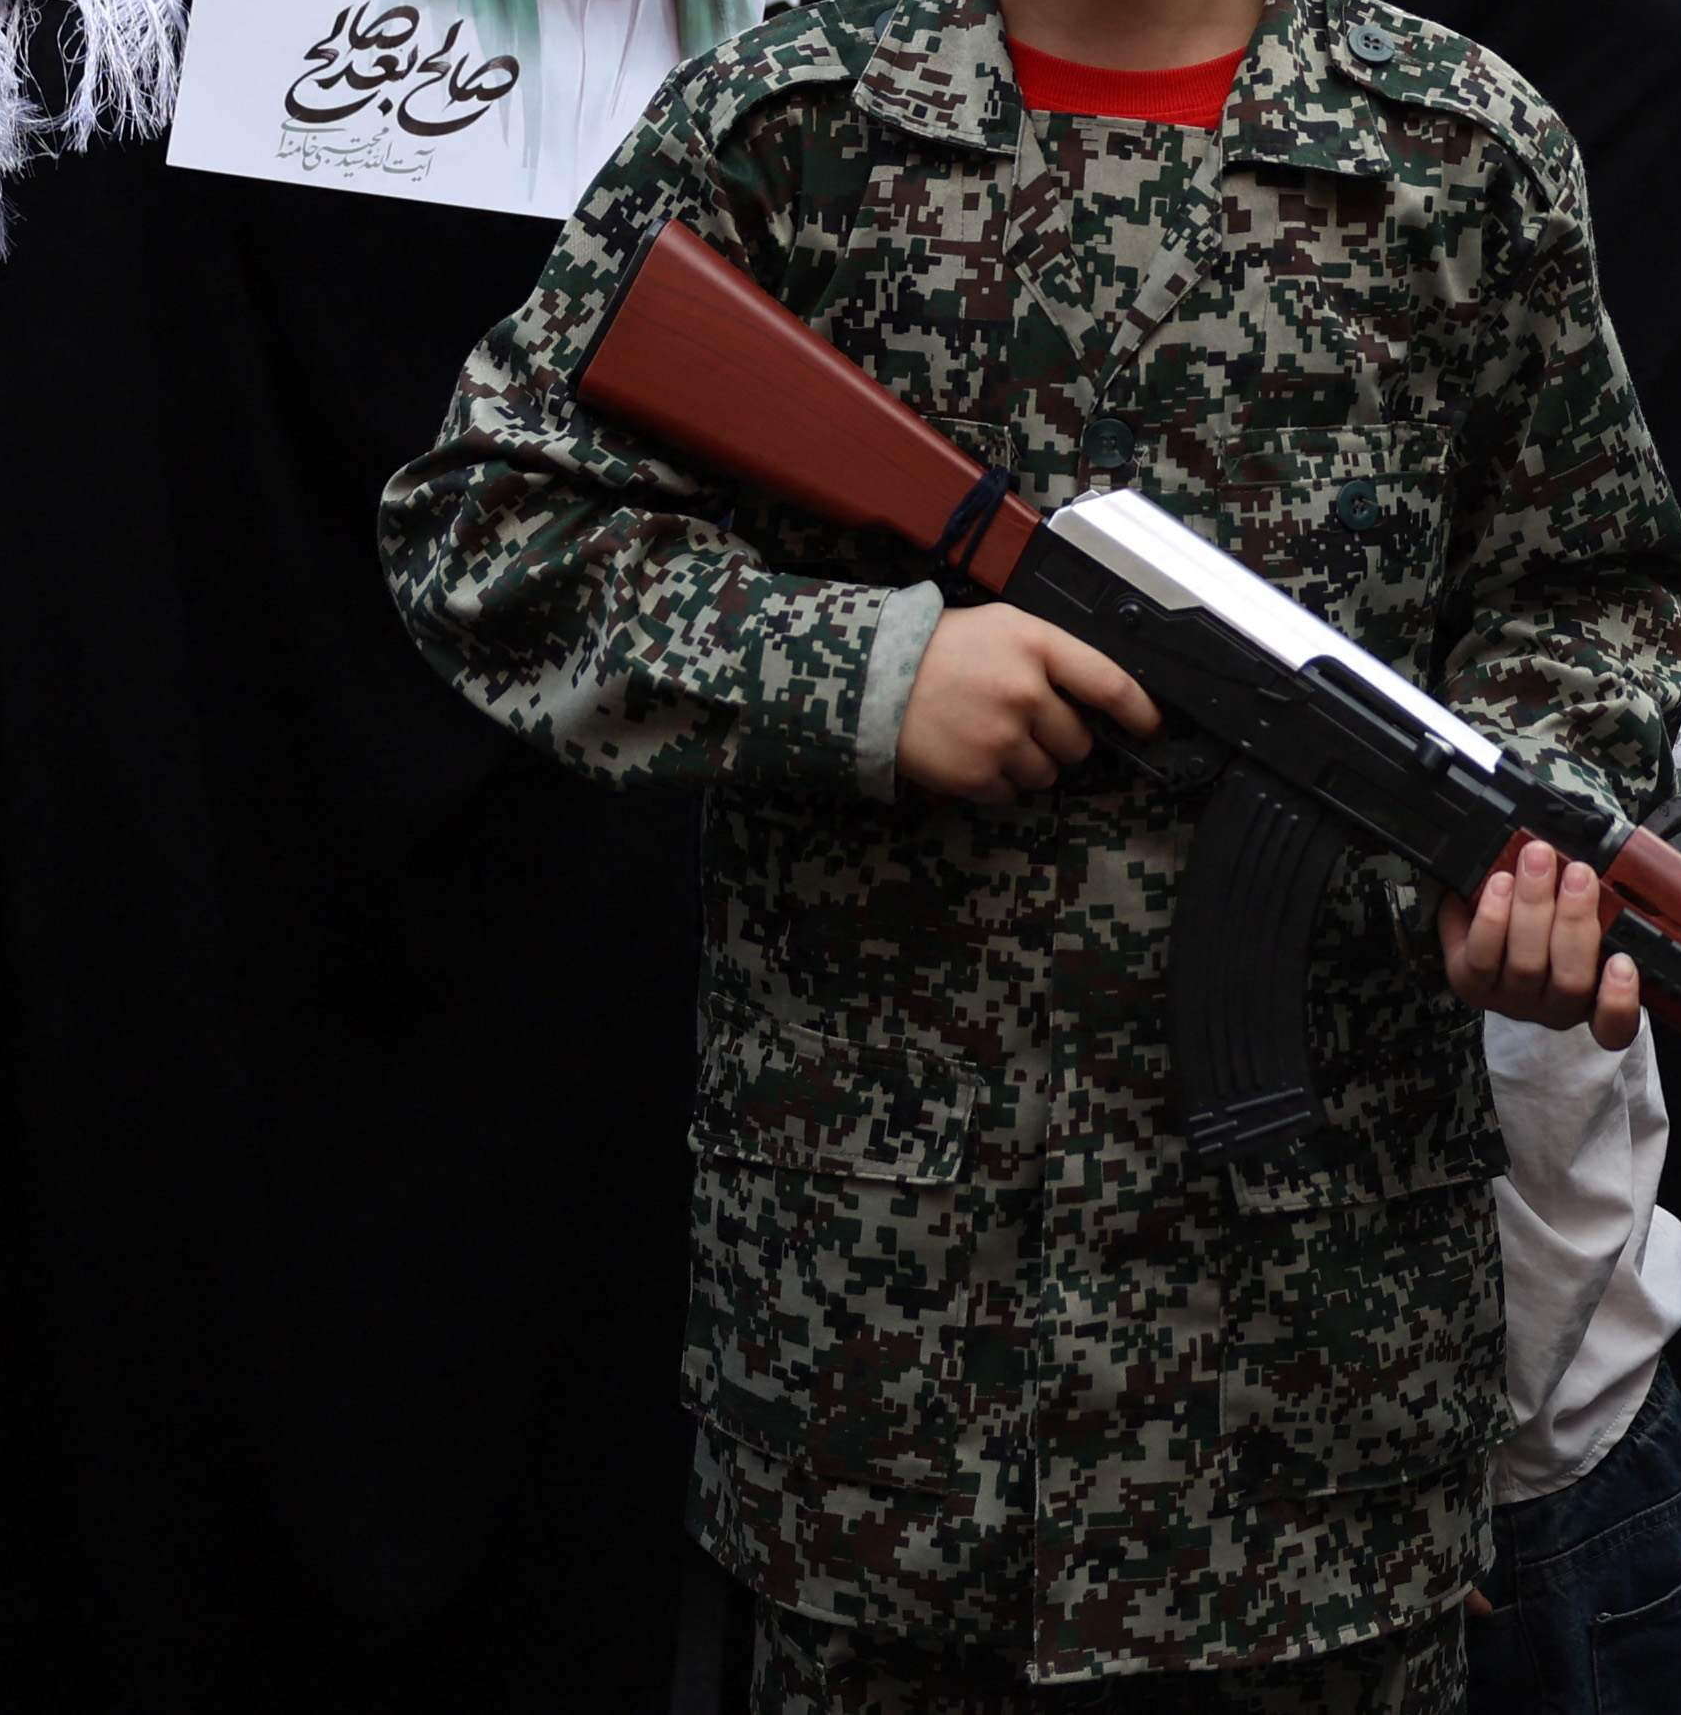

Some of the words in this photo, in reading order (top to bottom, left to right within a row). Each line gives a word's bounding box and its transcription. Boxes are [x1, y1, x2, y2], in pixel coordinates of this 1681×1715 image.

[284, 0, 420, 124] صالح
[312, 43, 419, 117] بعد
[397, 18, 520, 137] صالح
